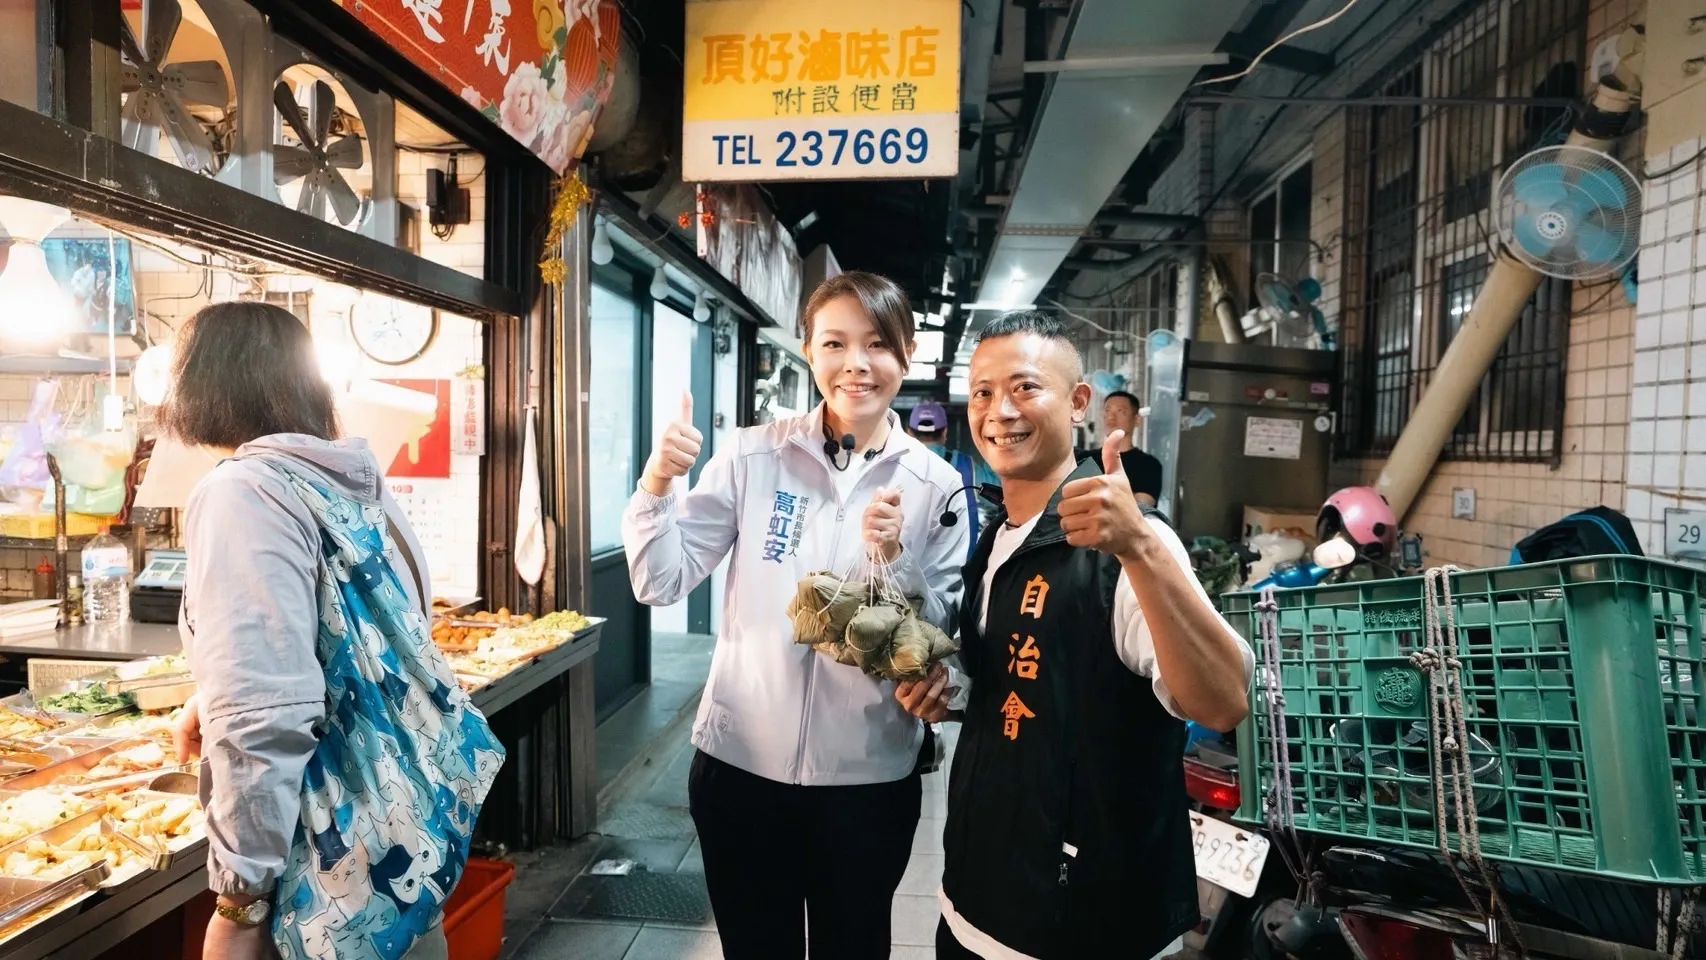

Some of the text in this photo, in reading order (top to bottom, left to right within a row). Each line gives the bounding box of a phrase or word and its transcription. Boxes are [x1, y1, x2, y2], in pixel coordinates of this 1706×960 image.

[702, 25, 939, 85] 頂好滷味店
[773, 82, 917, 115] 附設便當
[713, 127, 928, 167] TEL 237669
[762, 490, 797, 564] 高虹安
[788, 496, 809, 557] 新竹市長候選人
[1678, 524, 1700, 544] 29
[1000, 574, 1050, 741] 自治會
